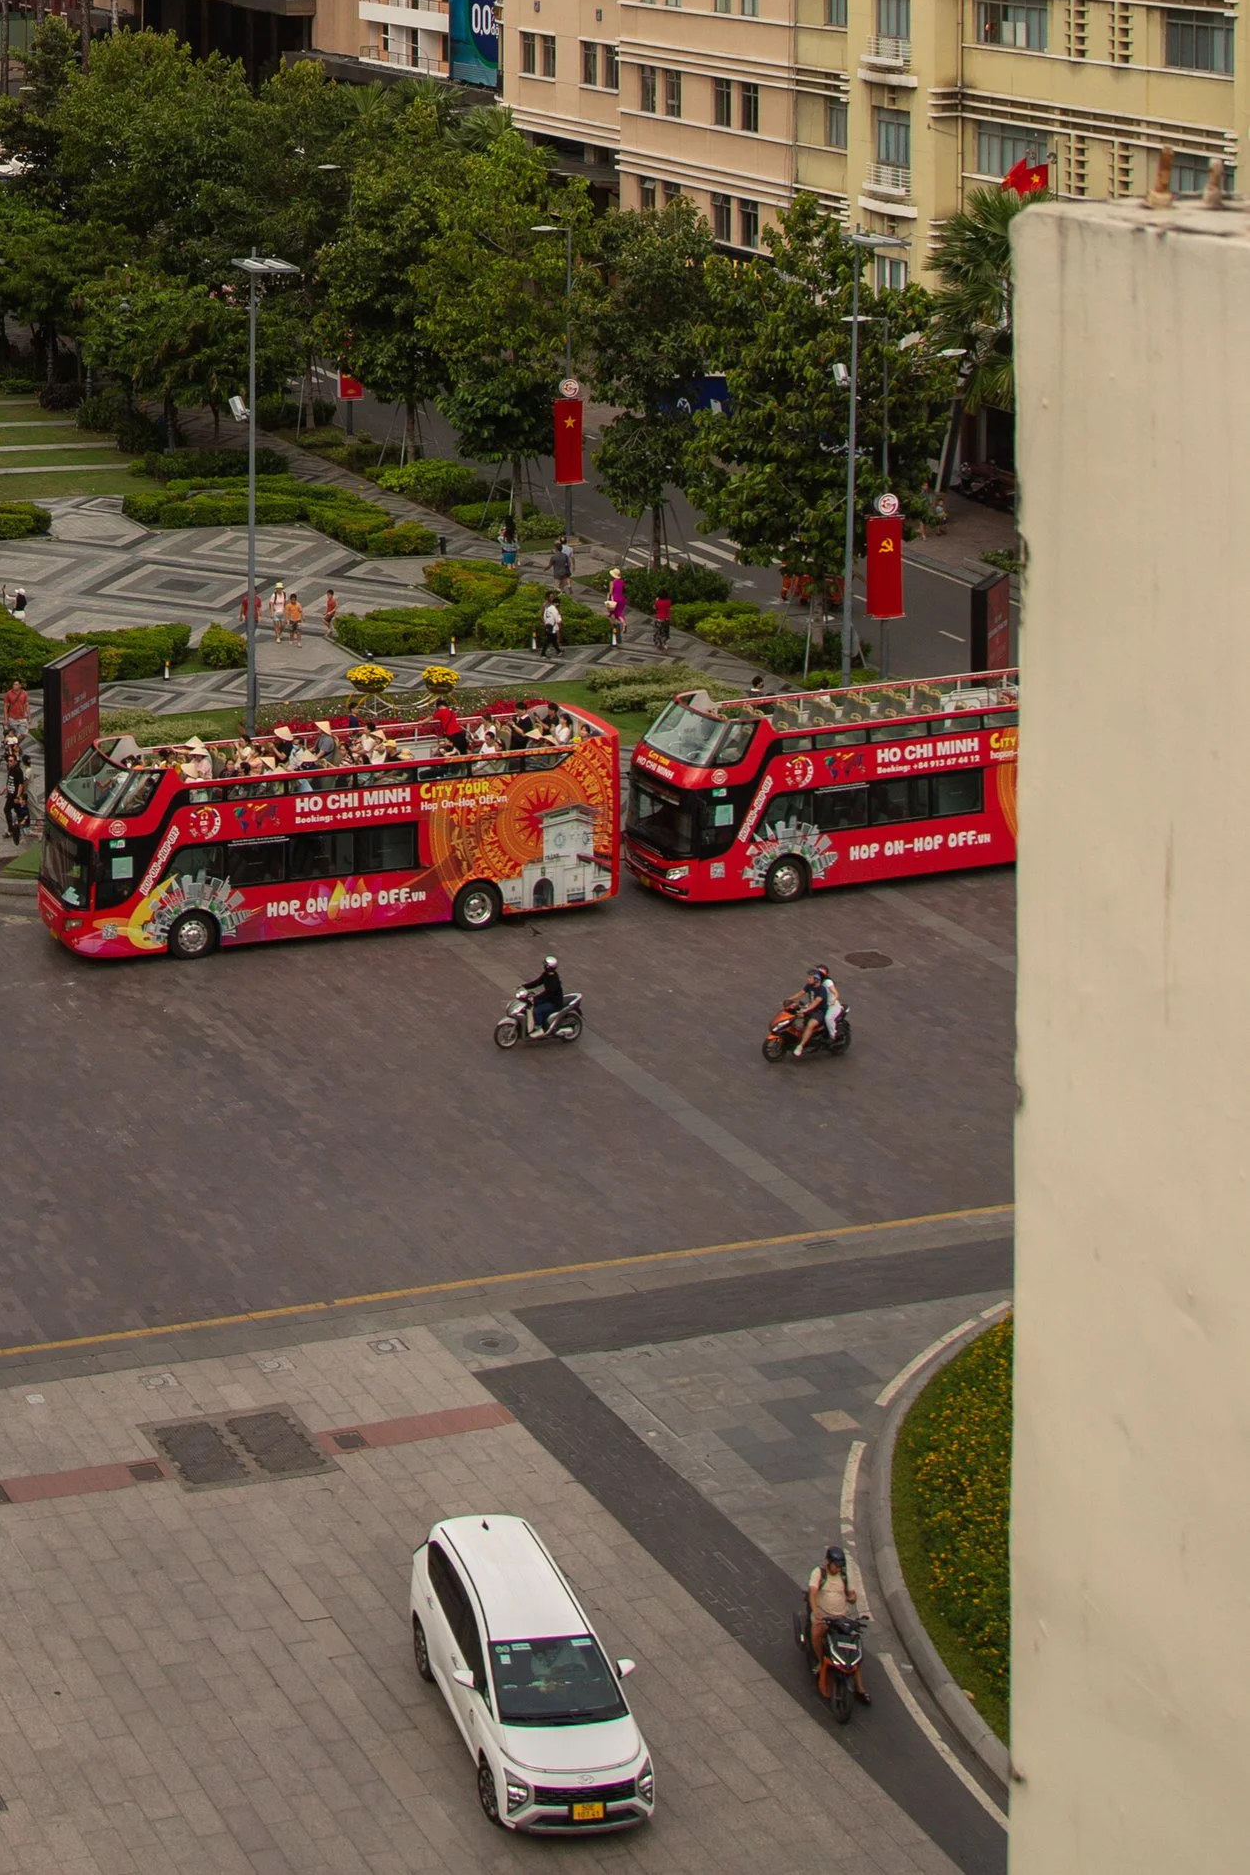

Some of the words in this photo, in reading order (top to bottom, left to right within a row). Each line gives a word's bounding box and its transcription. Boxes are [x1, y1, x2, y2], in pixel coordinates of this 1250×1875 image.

[877, 747, 901, 763] HO
[904, 743, 933, 760] CHI
[936, 737, 979, 756] MINH
[990, 733, 1017, 749] CITY
[636, 755, 646, 765] HO
[646, 760, 656, 771] CHI
[656, 765, 675, 779] MINH
[970, 754, 980, 762] 12
[420, 782, 452, 799] CITY
[457, 780, 490, 795] TOUR
[295, 796, 322, 813] HO
[327, 792, 358, 809] CHI
[363, 787, 411, 806] MINH
[420, 801, 438, 812] Hop
[295, 813, 333, 824] Booking:
[335, 810, 353, 820] +84
[355, 808, 371, 818] 913
[374, 807, 384, 817] 67
[387, 806, 398, 815] 44
[400, 805, 411, 814] 12
[849, 843, 880, 861] HOP
[266, 899, 300, 918] HOP
